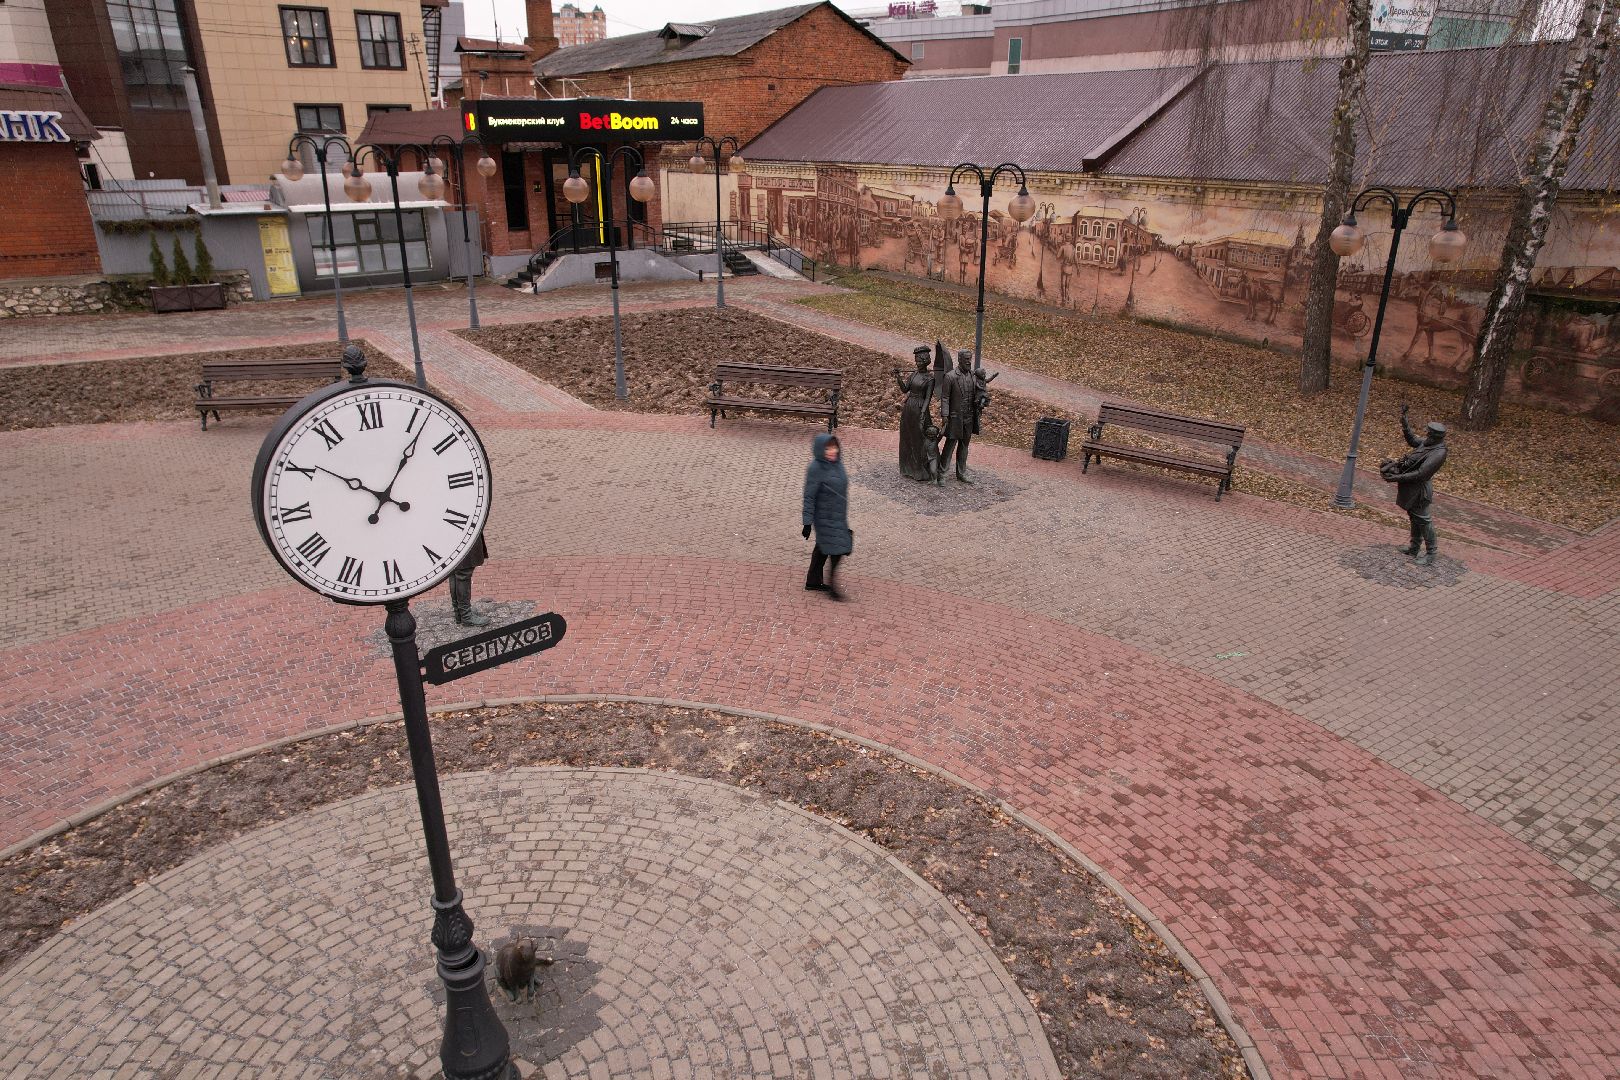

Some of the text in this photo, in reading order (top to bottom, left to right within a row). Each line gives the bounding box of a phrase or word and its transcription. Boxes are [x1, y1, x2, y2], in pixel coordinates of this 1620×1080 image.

[0, 112, 68, 140] НК
[488, 116, 565, 127] Букмекерский клуб
[579, 112, 659, 130] BetBoom
[670, 116, 680, 125] 24
[442, 622, 553, 670] СЕРПУХОВ
